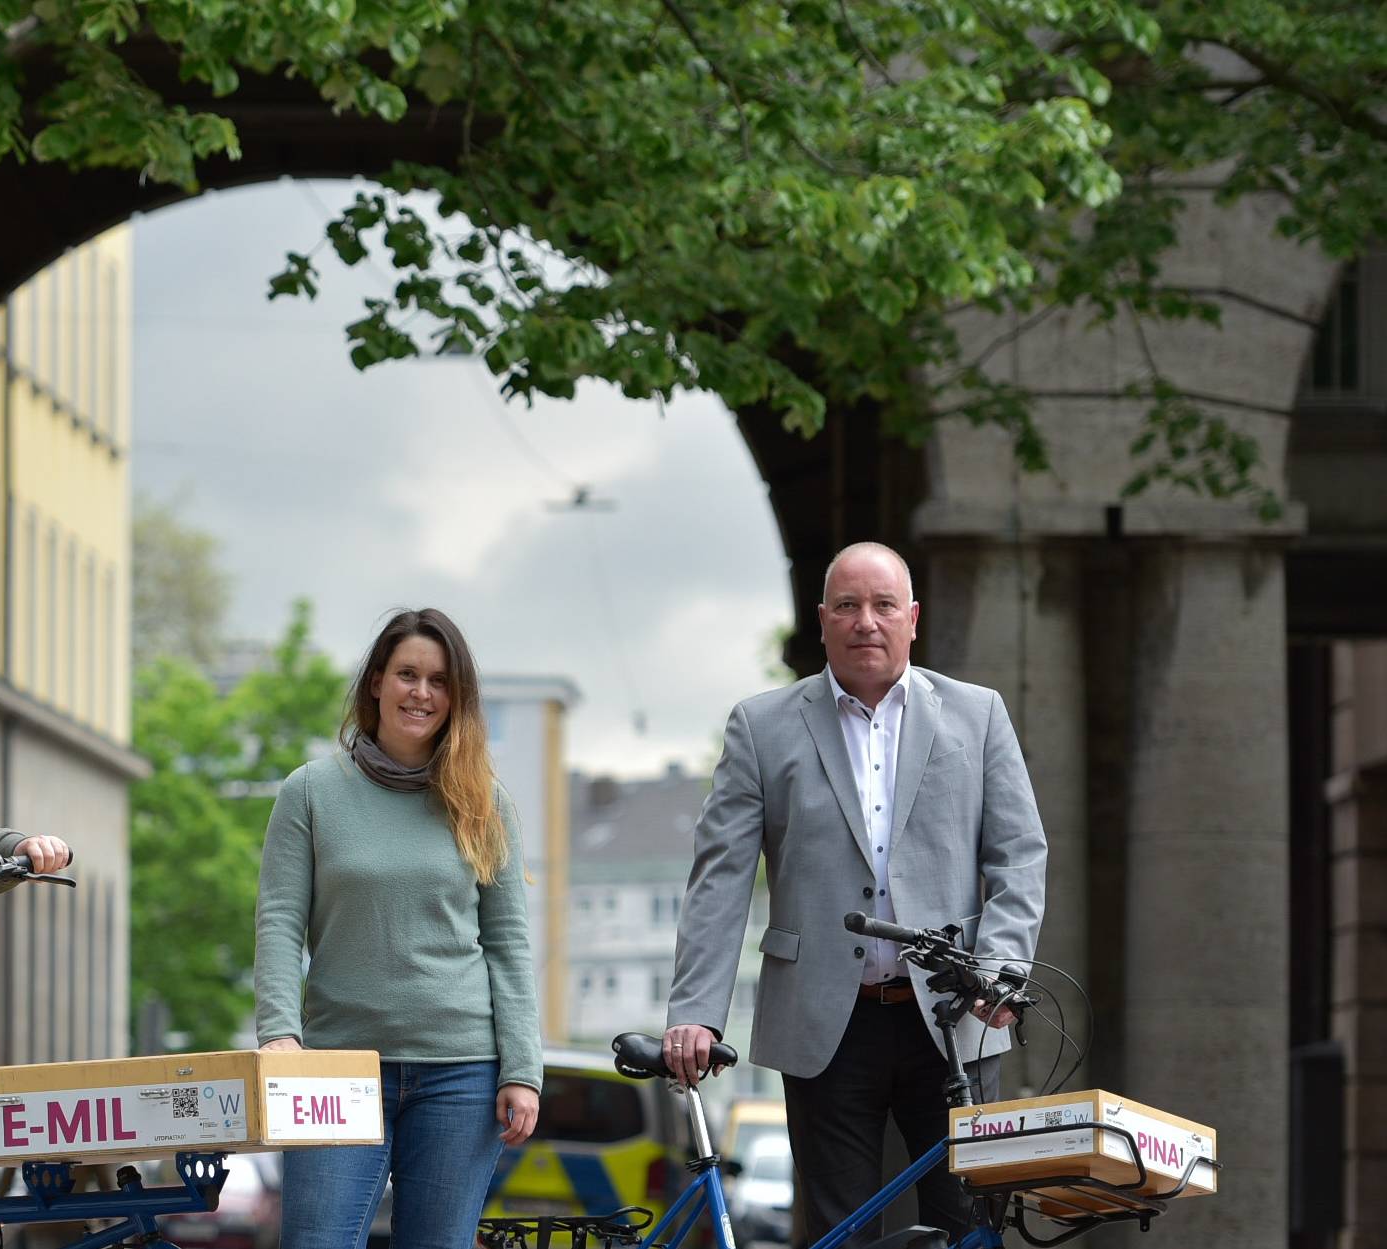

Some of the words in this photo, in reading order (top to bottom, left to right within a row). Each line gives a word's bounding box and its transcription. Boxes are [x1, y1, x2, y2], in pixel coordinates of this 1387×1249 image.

[2, 1097, 137, 1148] E-MIL
[293, 1095, 347, 1125] E-MIL
[972, 1120, 1015, 1137] PINA
